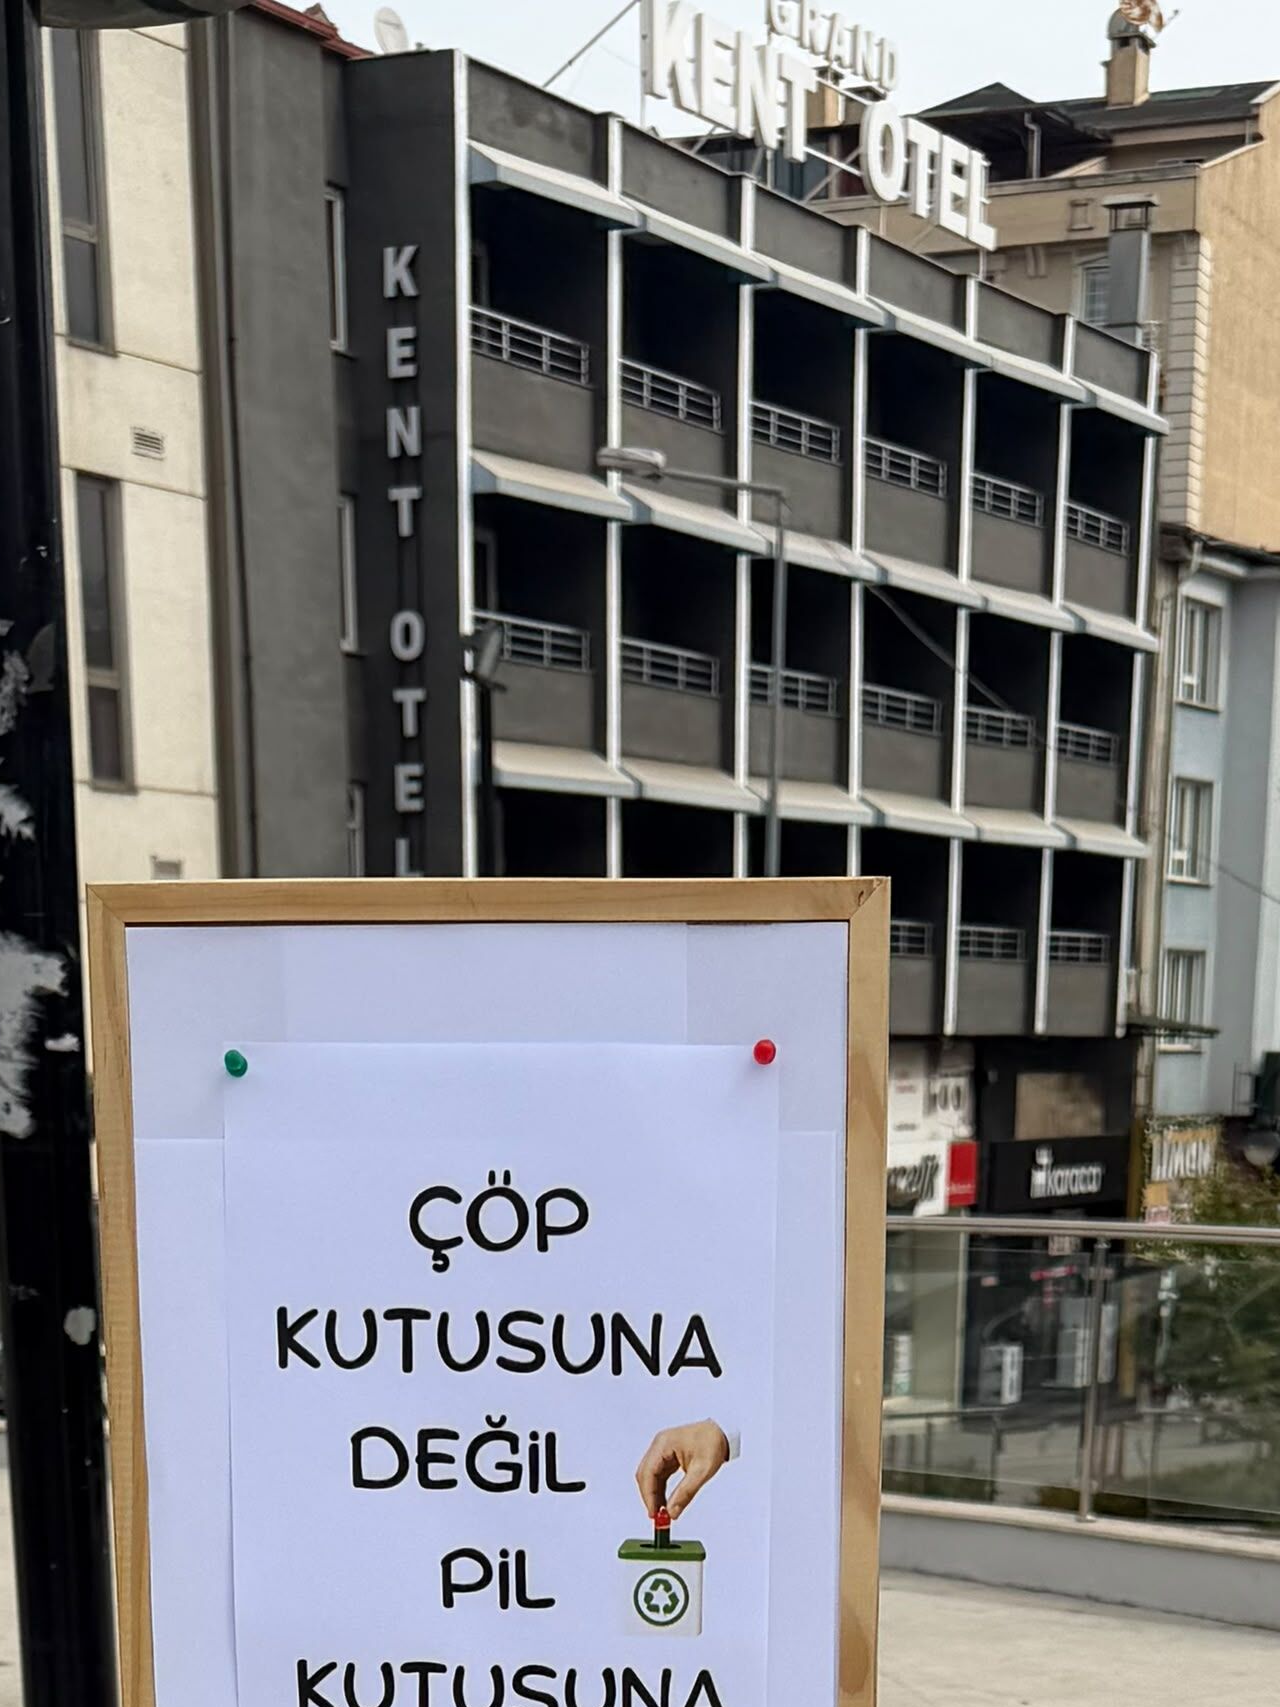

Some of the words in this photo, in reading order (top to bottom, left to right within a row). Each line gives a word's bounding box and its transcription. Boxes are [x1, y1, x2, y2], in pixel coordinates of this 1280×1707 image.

[765, 0, 898, 92] GRAND
[640, 0, 818, 163] KENT
[860, 101, 997, 251] OTEL
[383, 245, 422, 537] KENT
[389, 611, 426, 877] OTEL
[409, 1170, 589, 1272] ÇÖP
[276, 1307, 723, 1378] KUTUSUNA
[351, 1414, 586, 1494] DEĞİL
[441, 1549, 556, 1610] PİL
